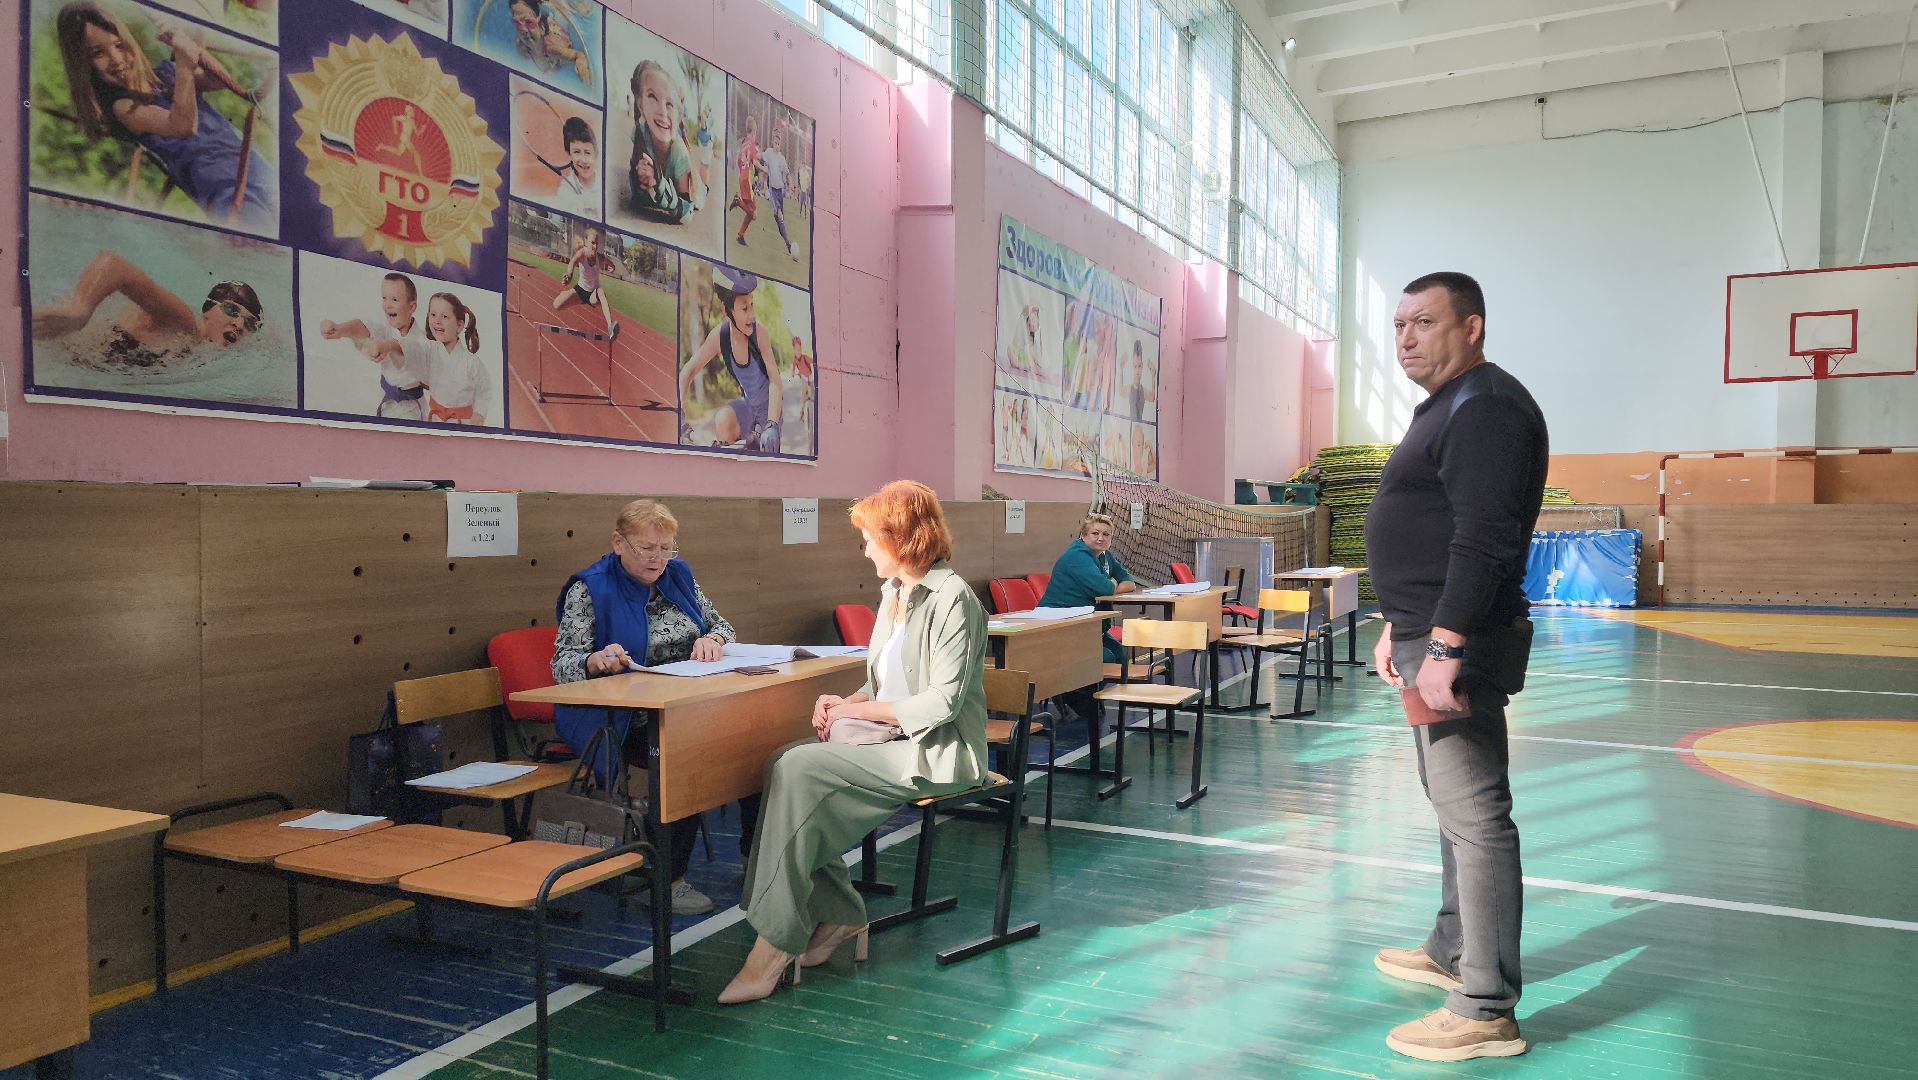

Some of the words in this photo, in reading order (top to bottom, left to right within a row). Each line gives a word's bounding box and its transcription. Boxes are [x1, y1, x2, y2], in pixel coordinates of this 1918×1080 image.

[379, 170, 430, 204] ГТО
[398, 213, 410, 238] 1
[464, 503, 501, 515] Переулок
[467, 518, 500, 527] Зеленый
